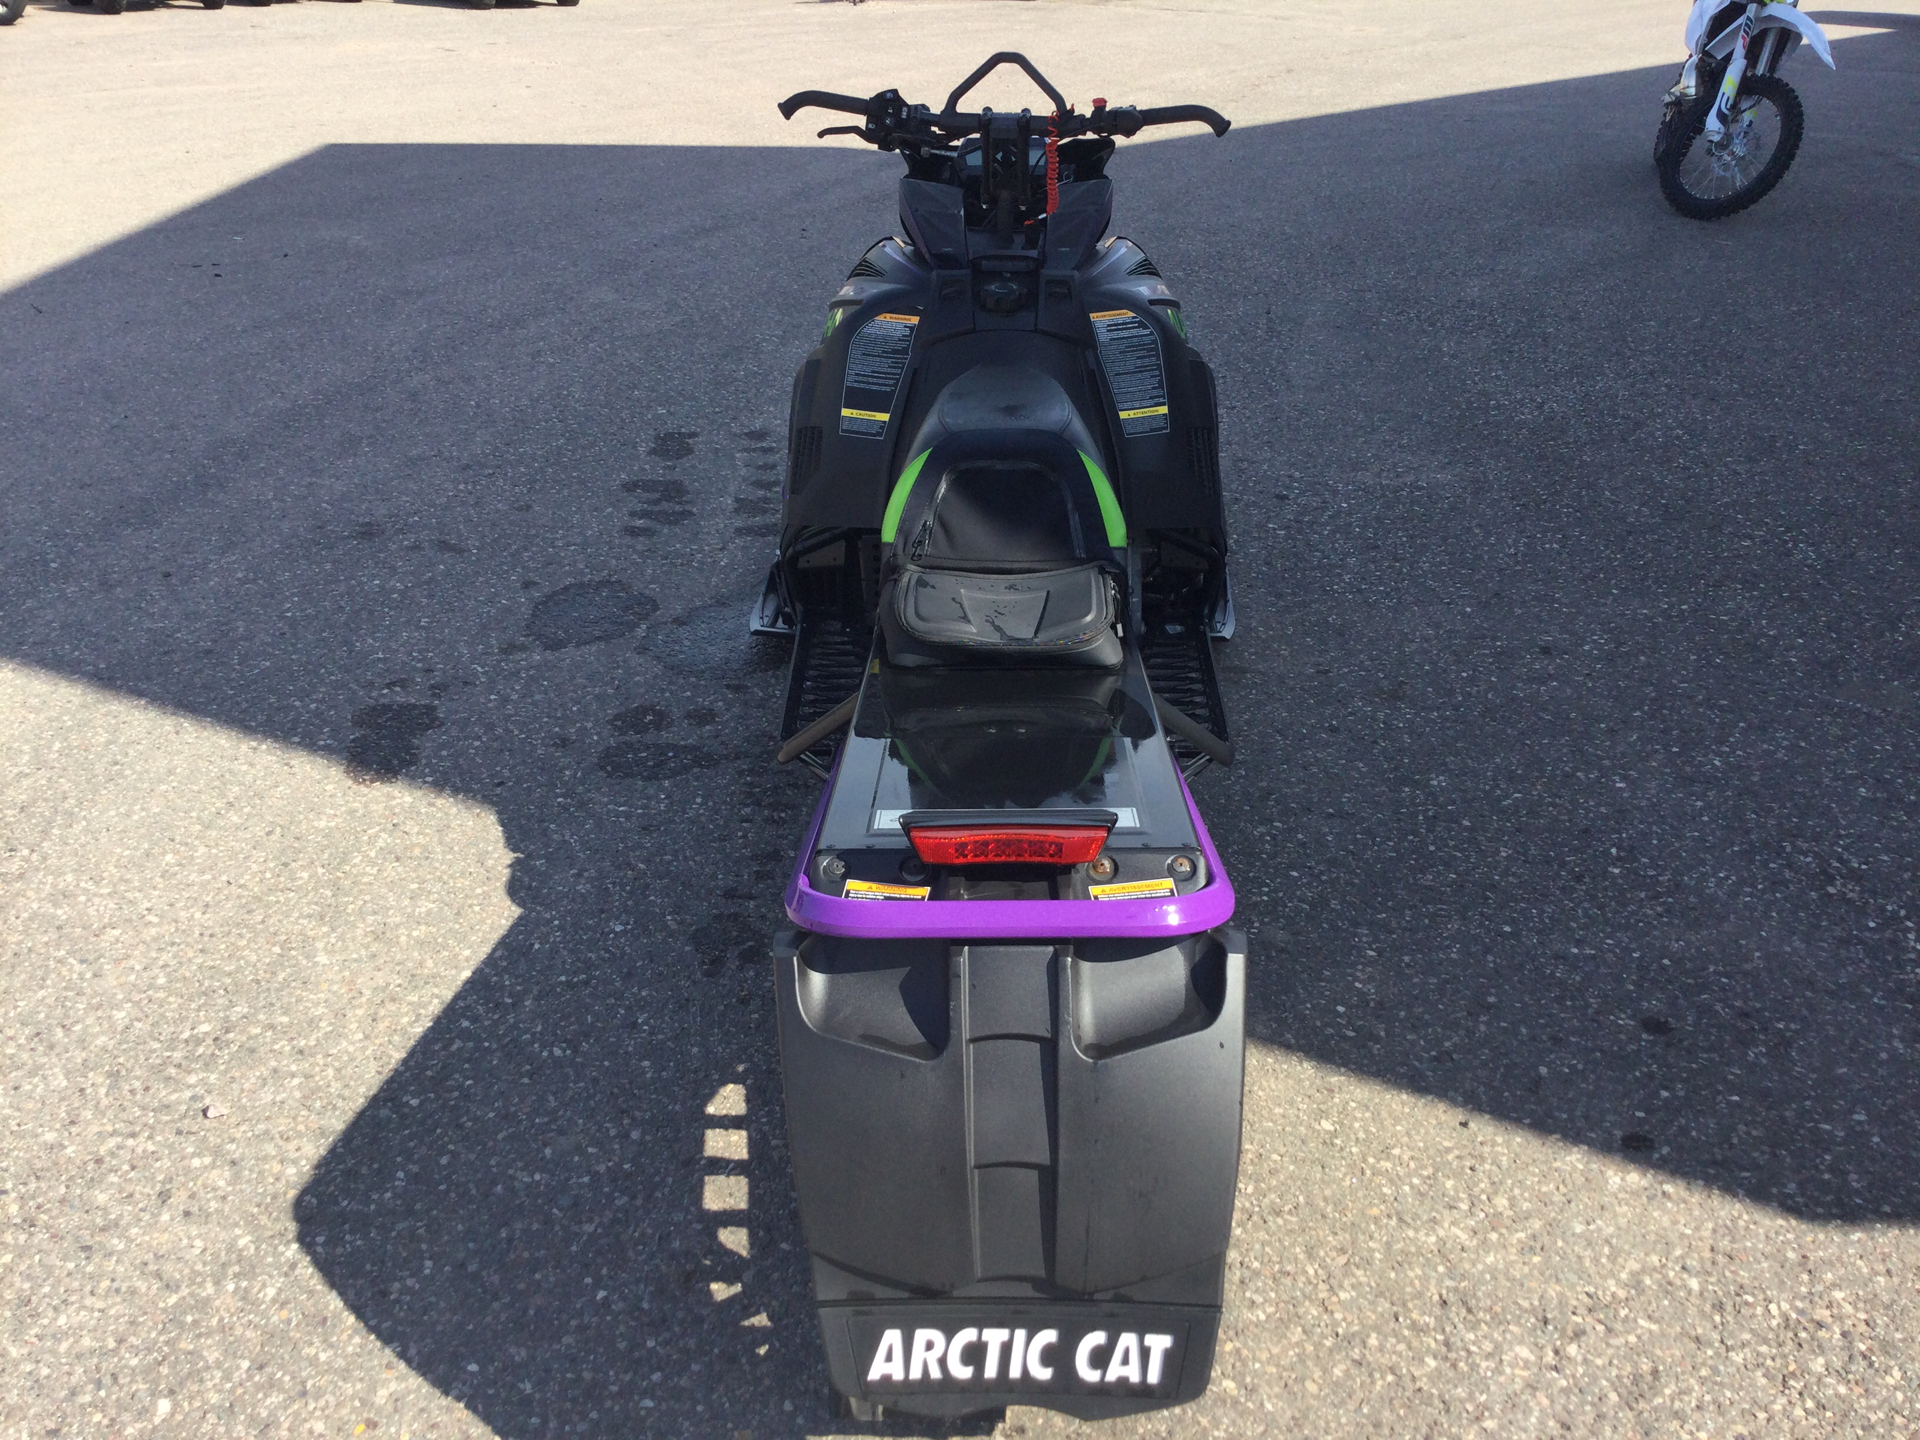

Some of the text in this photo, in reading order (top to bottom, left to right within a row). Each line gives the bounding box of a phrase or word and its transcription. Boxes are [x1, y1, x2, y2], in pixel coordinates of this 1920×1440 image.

[875, 885, 908, 893] WARNING
[1108, 882, 1164, 893] AVERTISSEMENT
[867, 1327, 1174, 1385] ARCTIC CAT
